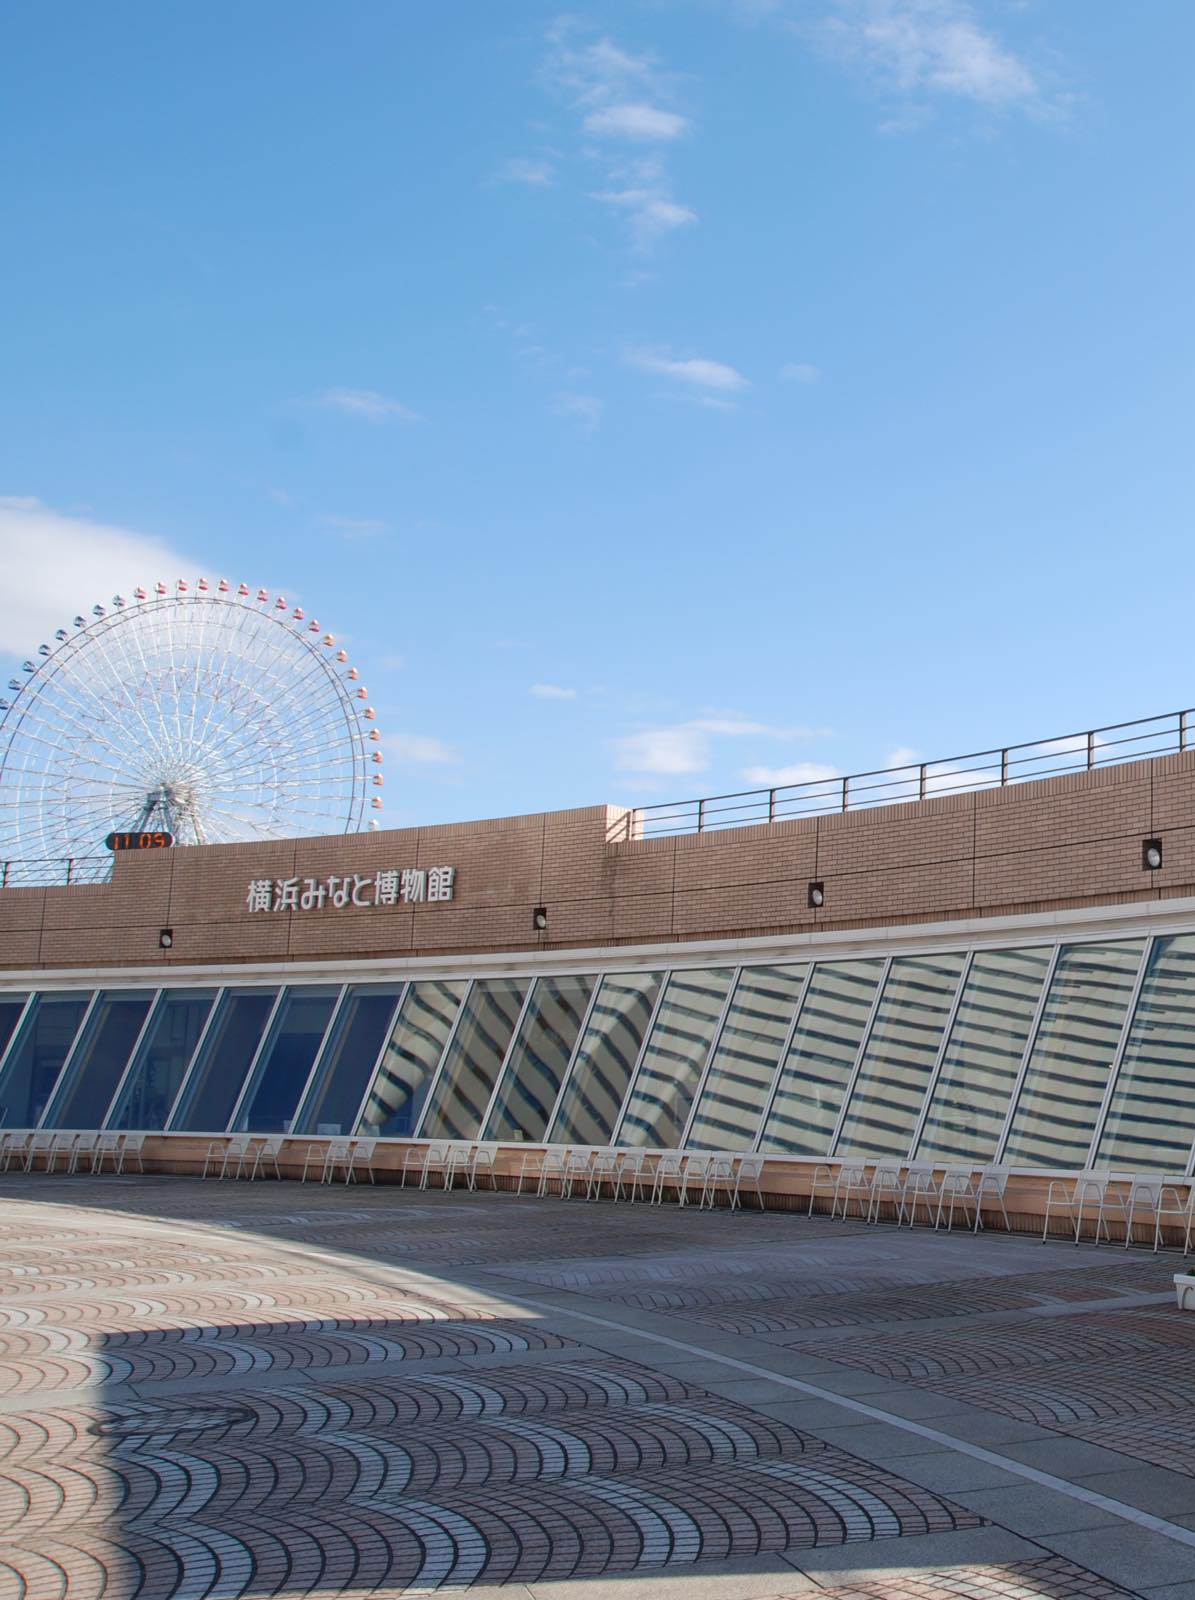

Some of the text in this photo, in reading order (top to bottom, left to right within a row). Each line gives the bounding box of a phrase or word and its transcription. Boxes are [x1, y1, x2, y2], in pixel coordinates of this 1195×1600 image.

[246, 865, 456, 913] 横浜みなと博物館
